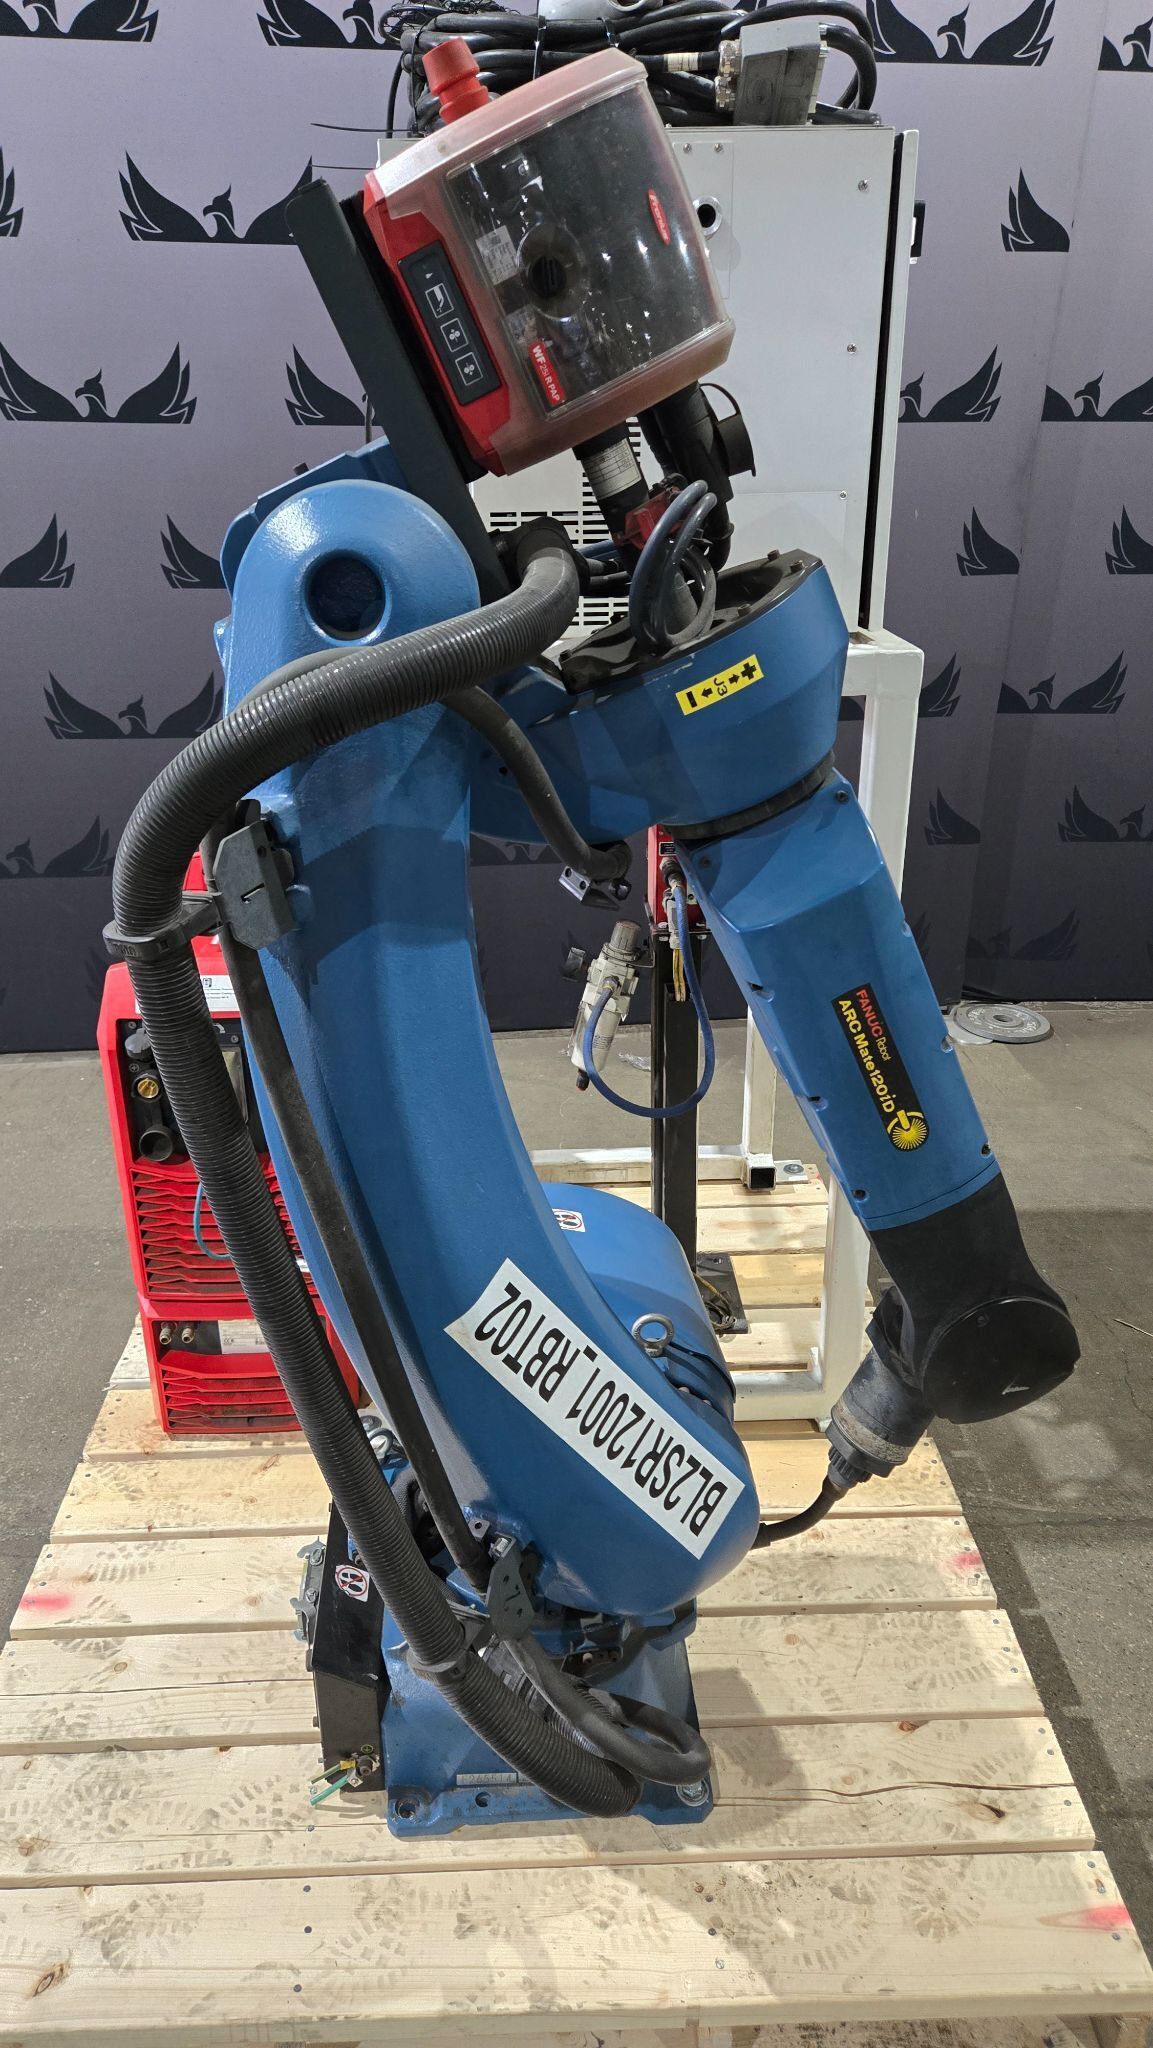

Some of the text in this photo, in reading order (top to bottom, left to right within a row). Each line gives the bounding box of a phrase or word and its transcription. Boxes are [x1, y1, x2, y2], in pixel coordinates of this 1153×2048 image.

[533, 345, 546, 364] WF
[545, 376, 553, 385] R
[548, 384, 560, 401] PAP
[713, 677, 728, 696] J3
[838, 999, 863, 1035] ARC
[855, 988, 892, 1062] FANUC Robot
[474, 1281, 729, 1537] BL2SR12001_RBT02
